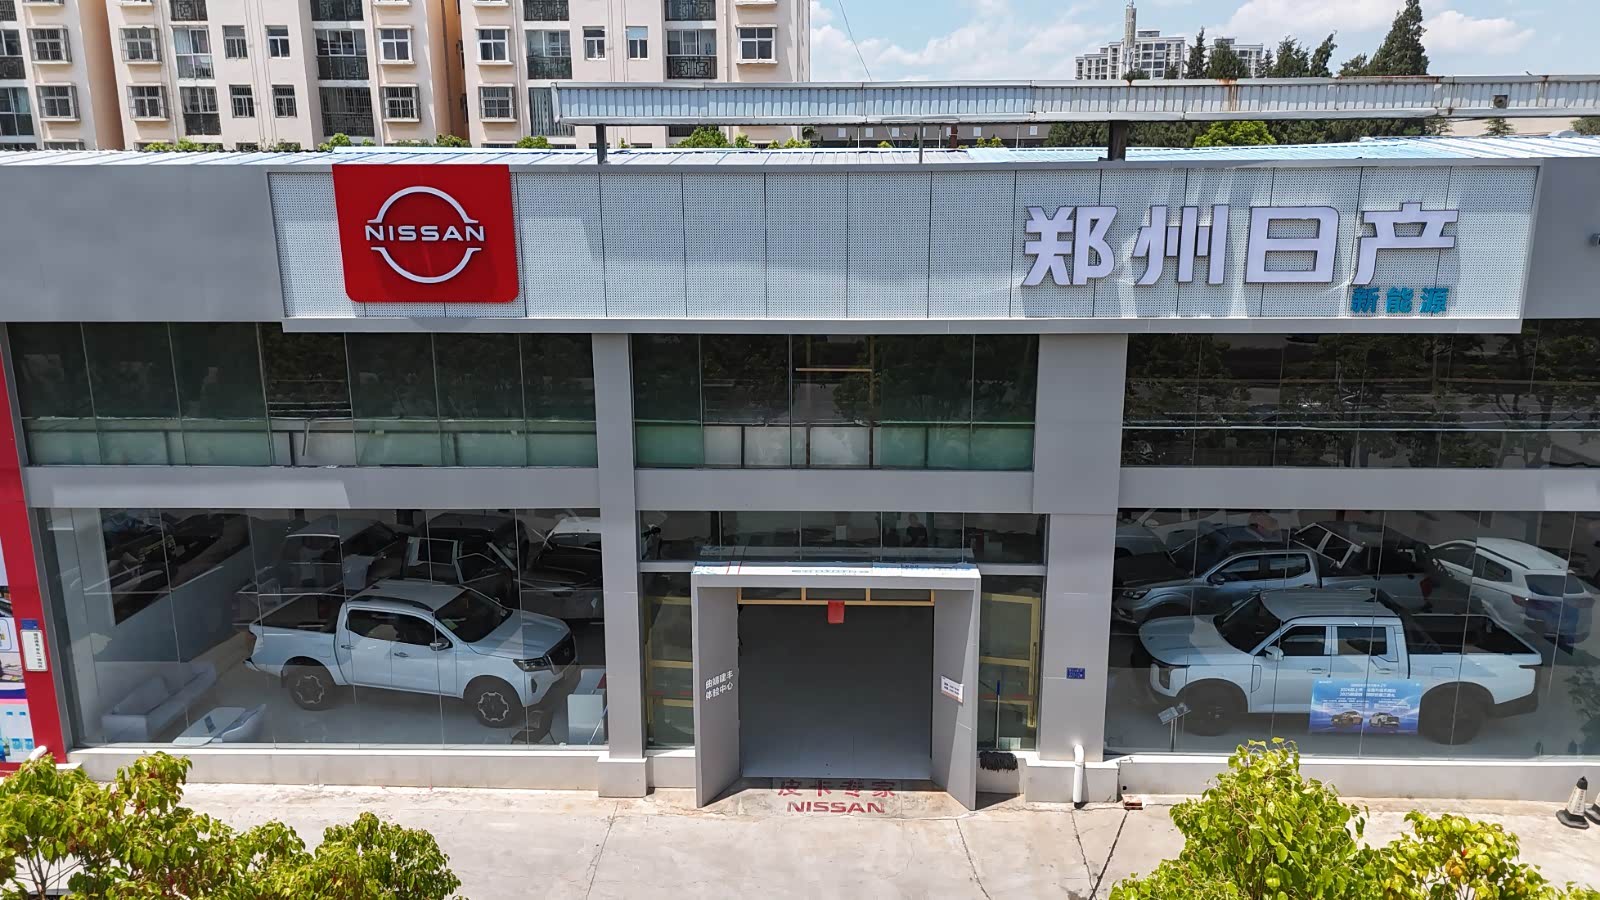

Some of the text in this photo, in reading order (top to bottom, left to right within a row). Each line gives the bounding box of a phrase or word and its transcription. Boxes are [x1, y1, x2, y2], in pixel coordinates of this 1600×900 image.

[364, 225, 485, 241] NISSAN
[1022, 203, 1459, 286] 郑州日产
[1350, 287, 1449, 314] 新能源
[705, 682, 733, 701] 体验中心
[778, 779, 896, 798] 皮卡专家
[786, 801, 885, 814] NISSAN
